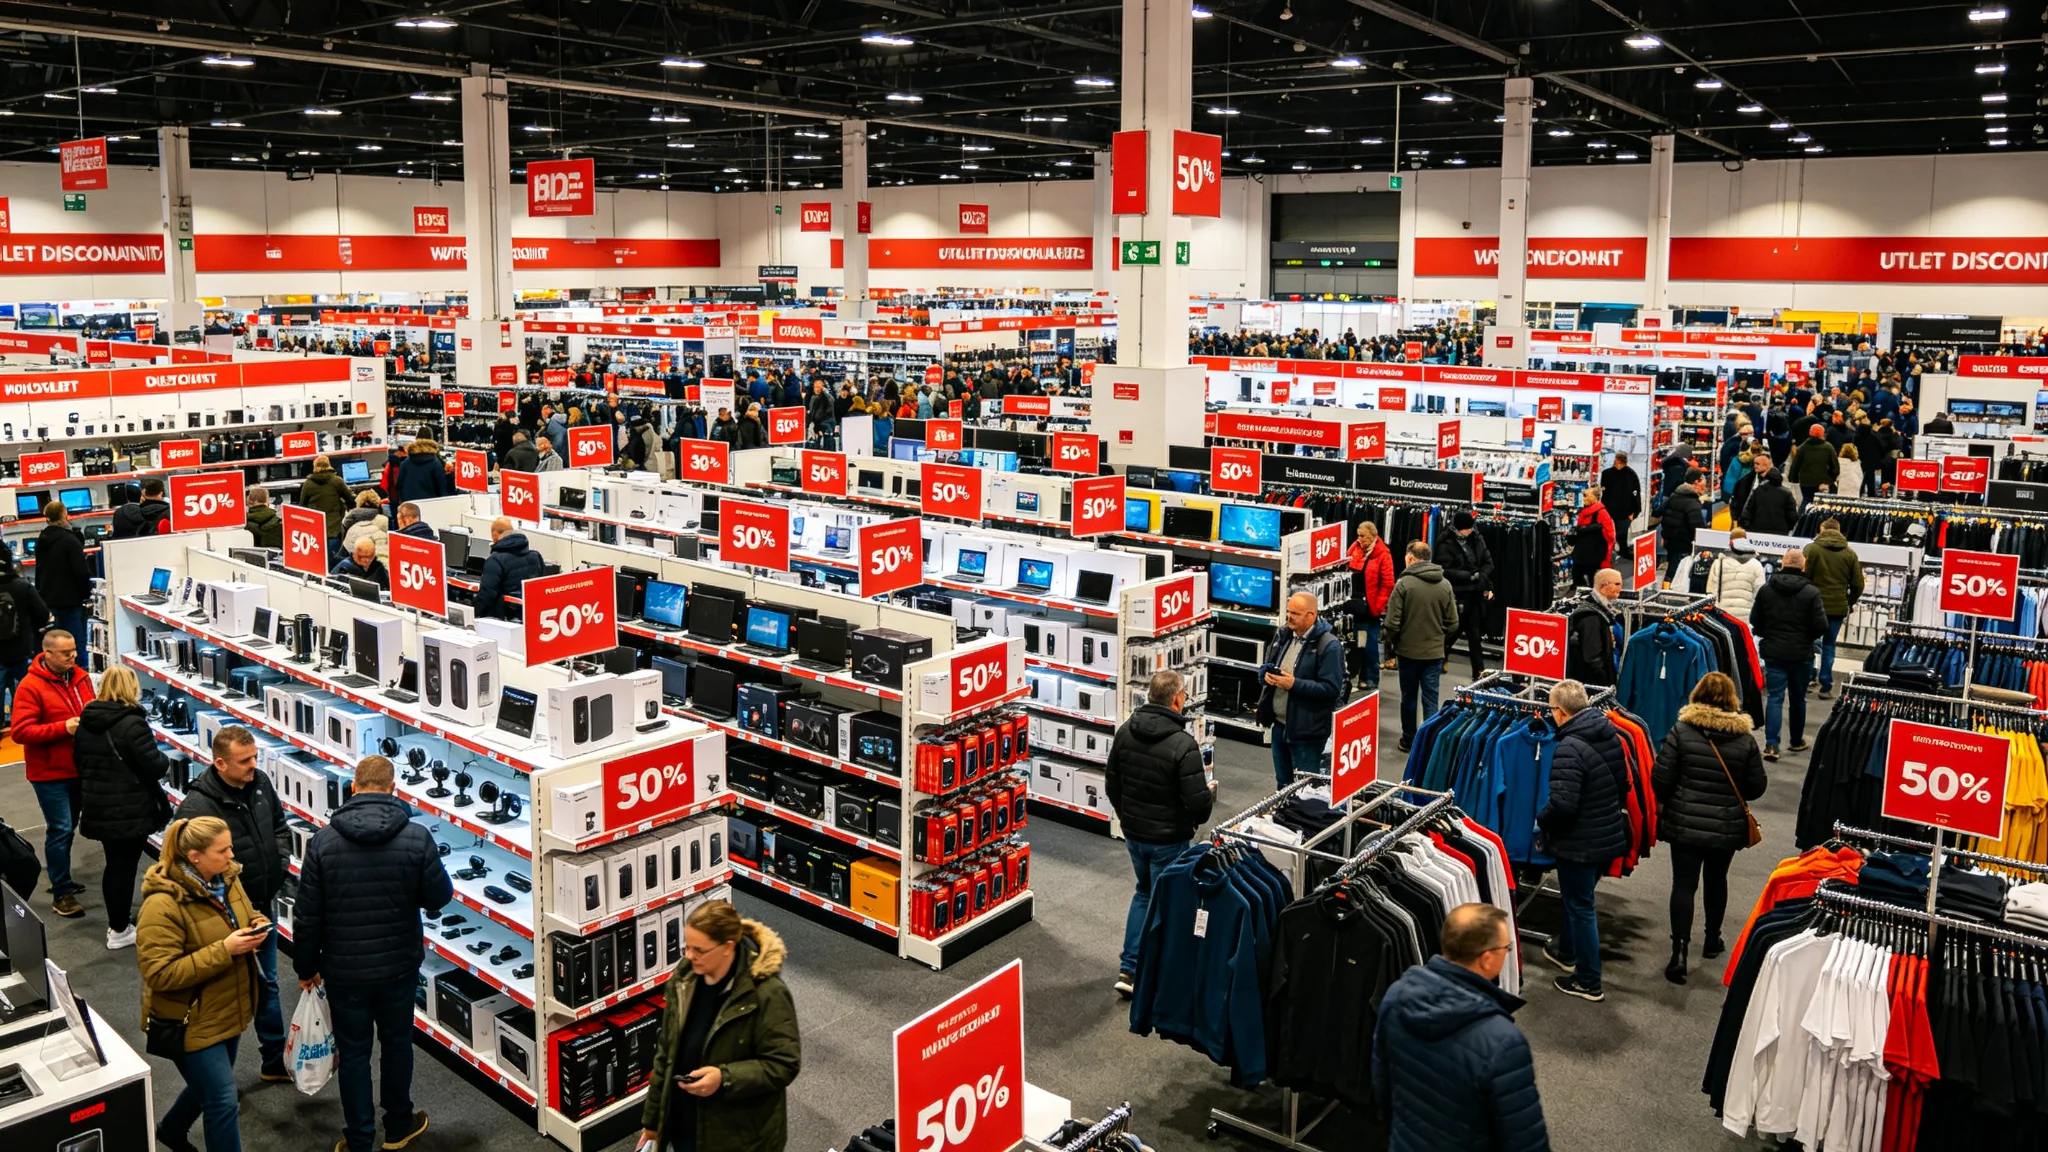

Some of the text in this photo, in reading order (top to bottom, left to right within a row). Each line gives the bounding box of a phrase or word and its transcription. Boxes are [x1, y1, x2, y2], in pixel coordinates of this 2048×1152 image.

[1177, 156, 1215, 192] 50%
[1880, 251, 1946, 270] UTLET
[184, 492, 235, 517] 50%
[931, 482, 970, 503] 50%
[1081, 497, 1118, 520] 50%
[291, 530, 320, 556] 50%
[732, 524, 776, 550] 50%
[400, 560, 437, 591] 50%
[871, 545, 914, 576] 50%
[1950, 573, 2007, 597] 50%
[539, 601, 604, 642] 50%
[1513, 634, 1560, 659] 50%
[958, 661, 1003, 698] 50%
[1337, 734, 1372, 777] 50%
[617, 762, 688, 810] 50%
[1899, 760, 1992, 804] 50%
[917, 1065, 1010, 1152] 50%
